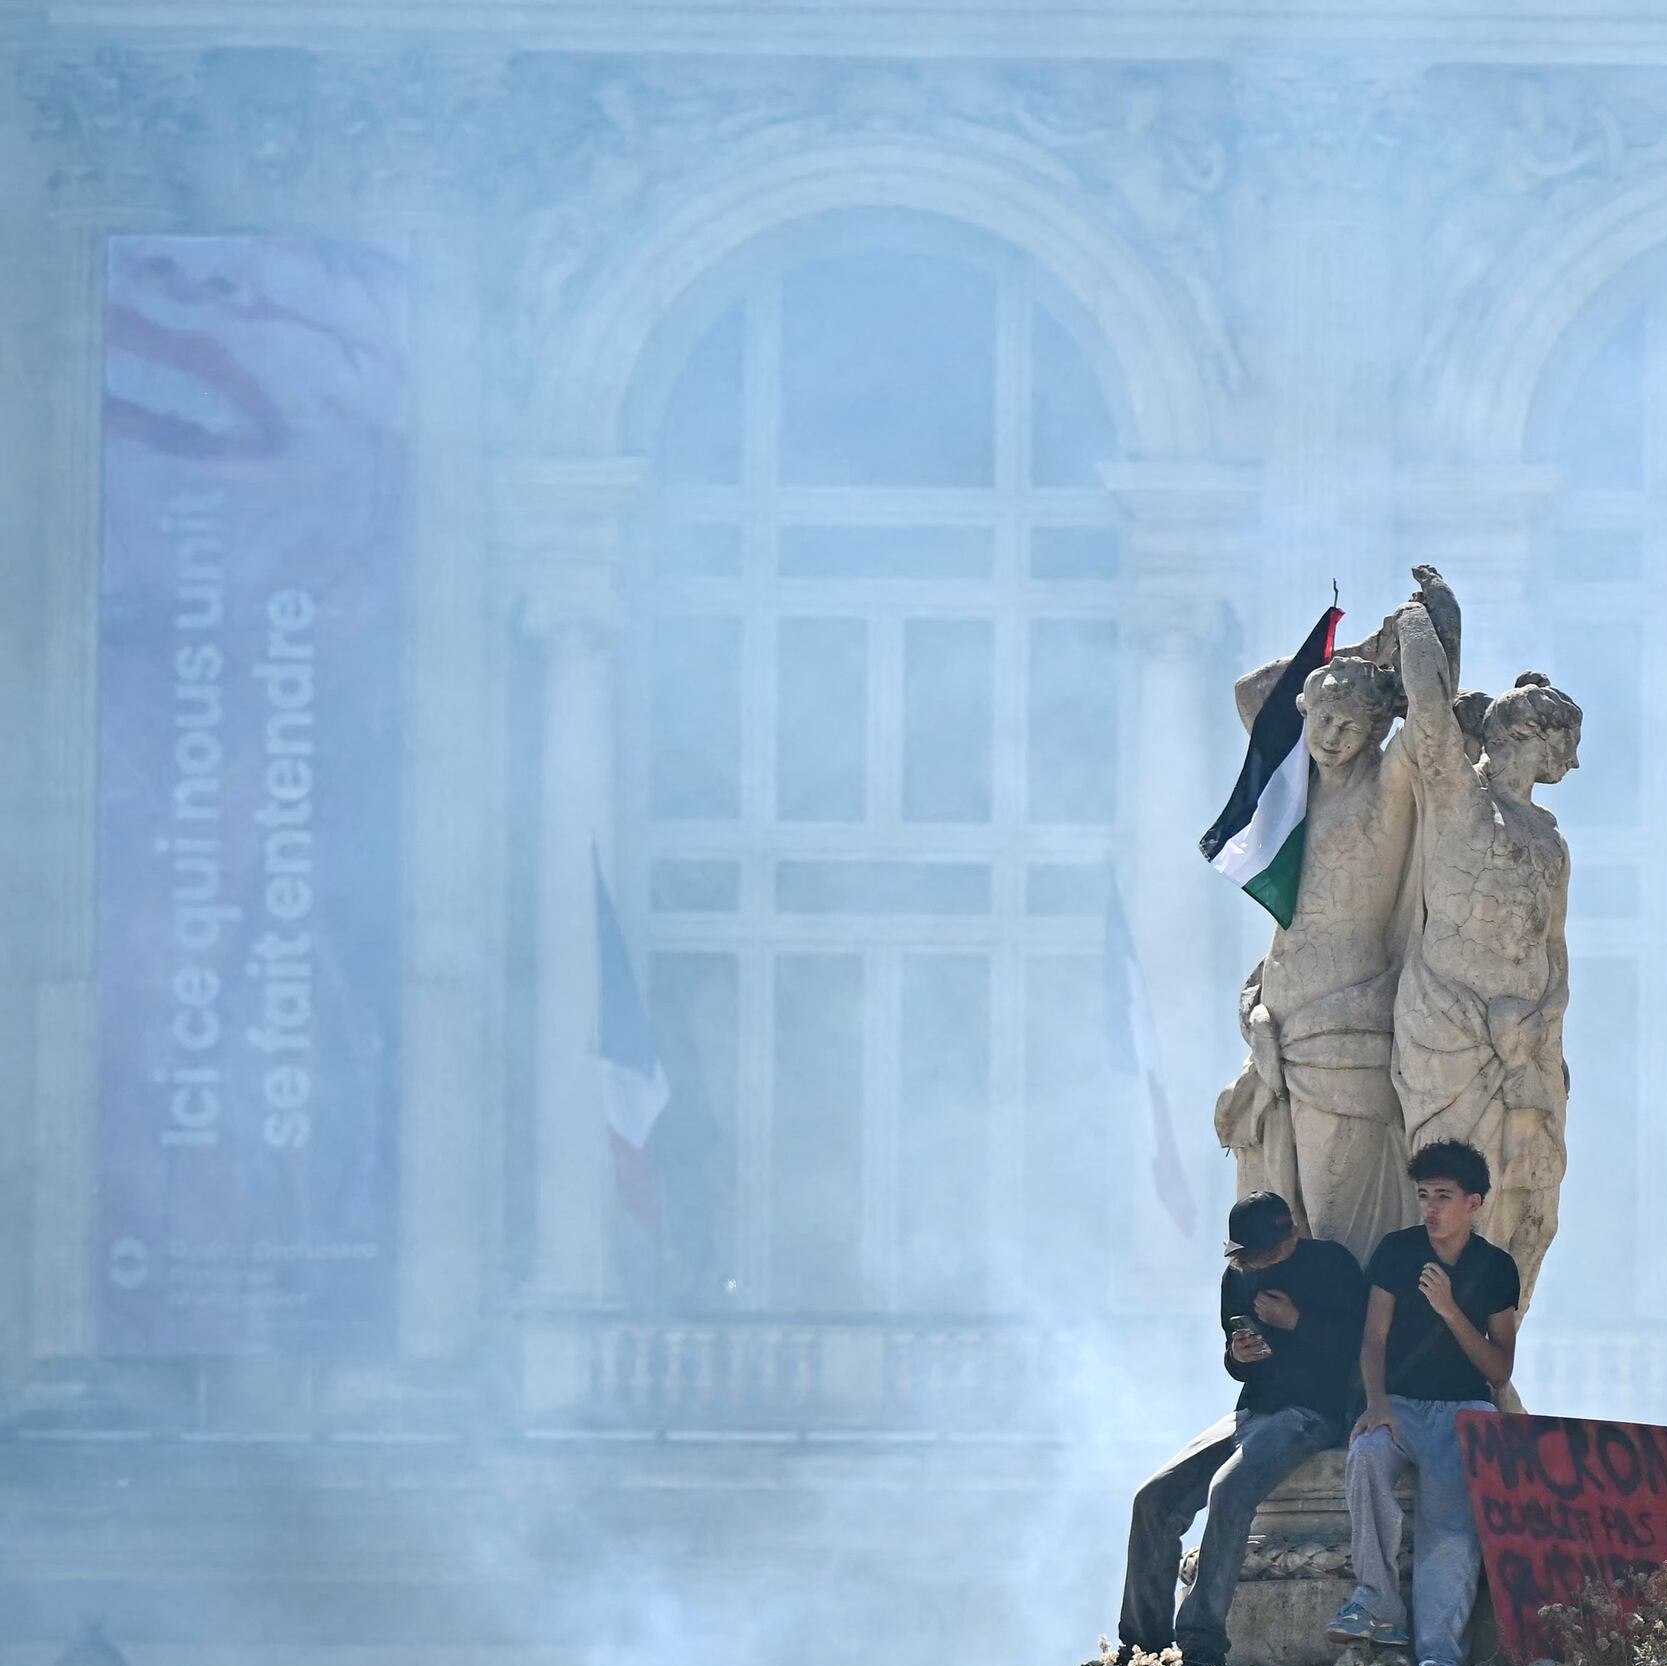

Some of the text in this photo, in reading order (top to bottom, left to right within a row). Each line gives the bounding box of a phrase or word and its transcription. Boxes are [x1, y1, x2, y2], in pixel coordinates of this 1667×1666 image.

[153, 488, 244, 1148] Ici ce qui nous unit
[244, 587, 316, 1149] se fait entendre
[1600, 1504, 1656, 1548] PAS
